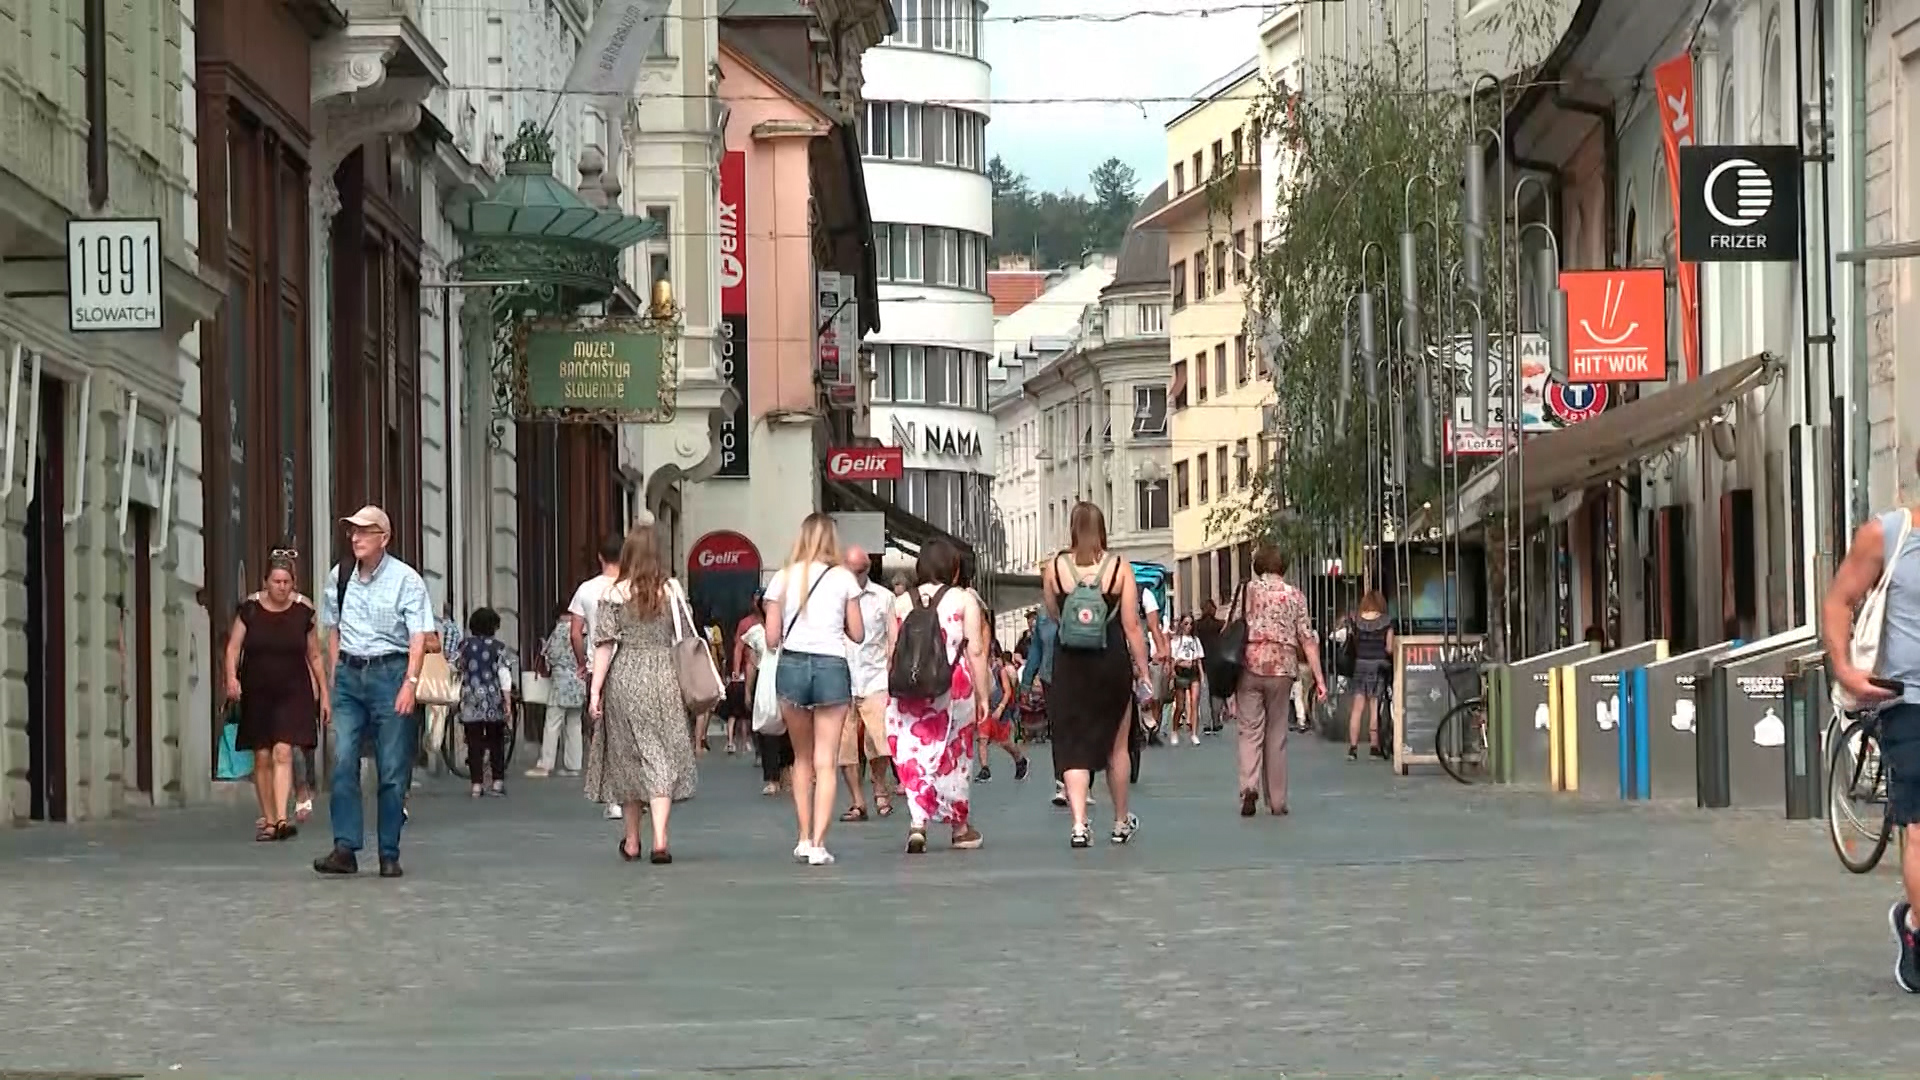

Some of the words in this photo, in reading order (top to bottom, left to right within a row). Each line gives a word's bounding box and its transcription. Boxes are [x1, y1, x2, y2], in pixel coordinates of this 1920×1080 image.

[1710, 234, 1767, 249] FRIZER
[78, 235, 151, 296] 1991
[75, 306, 155, 322] SLOWATCH
[573, 341, 615, 358] MUZEJ
[1574, 354, 1649, 374] HIT'WOK
[564, 382, 625, 398] SLOVENIJE
[925, 424, 982, 456] NAMA
[831, 453, 887, 475] Felix
[698, 549, 740, 567] Felix
